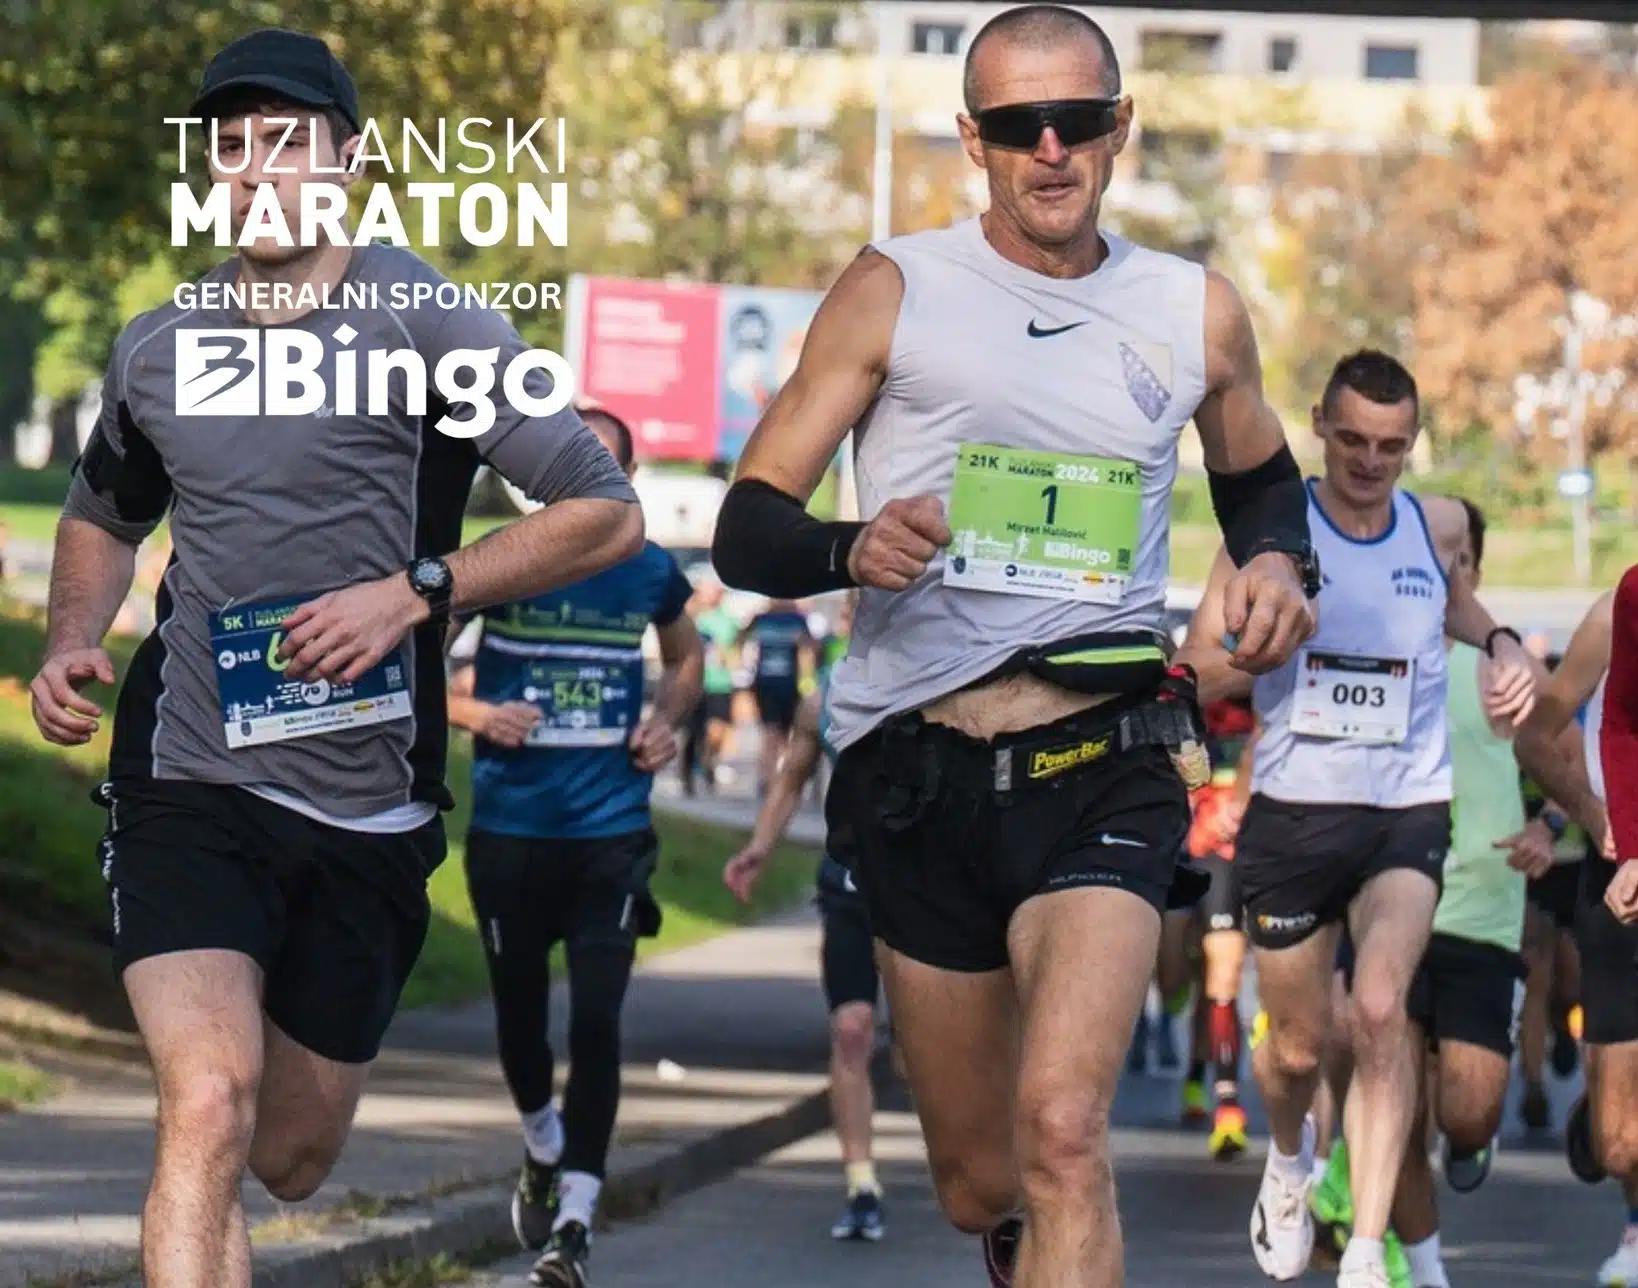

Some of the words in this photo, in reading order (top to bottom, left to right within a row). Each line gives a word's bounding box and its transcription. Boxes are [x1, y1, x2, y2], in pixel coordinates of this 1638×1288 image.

[969, 454, 999, 470] 21K
[1054, 463, 1099, 484] 2024
[1108, 470, 1136, 485] 21K
[1040, 484, 1058, 525] 1
[1062, 542, 1111, 566] Bingo
[223, 616, 244, 631] 5K
[236, 649, 261, 663] NLB
[553, 681, 601, 710] 543
[1332, 683, 1386, 708] 003
